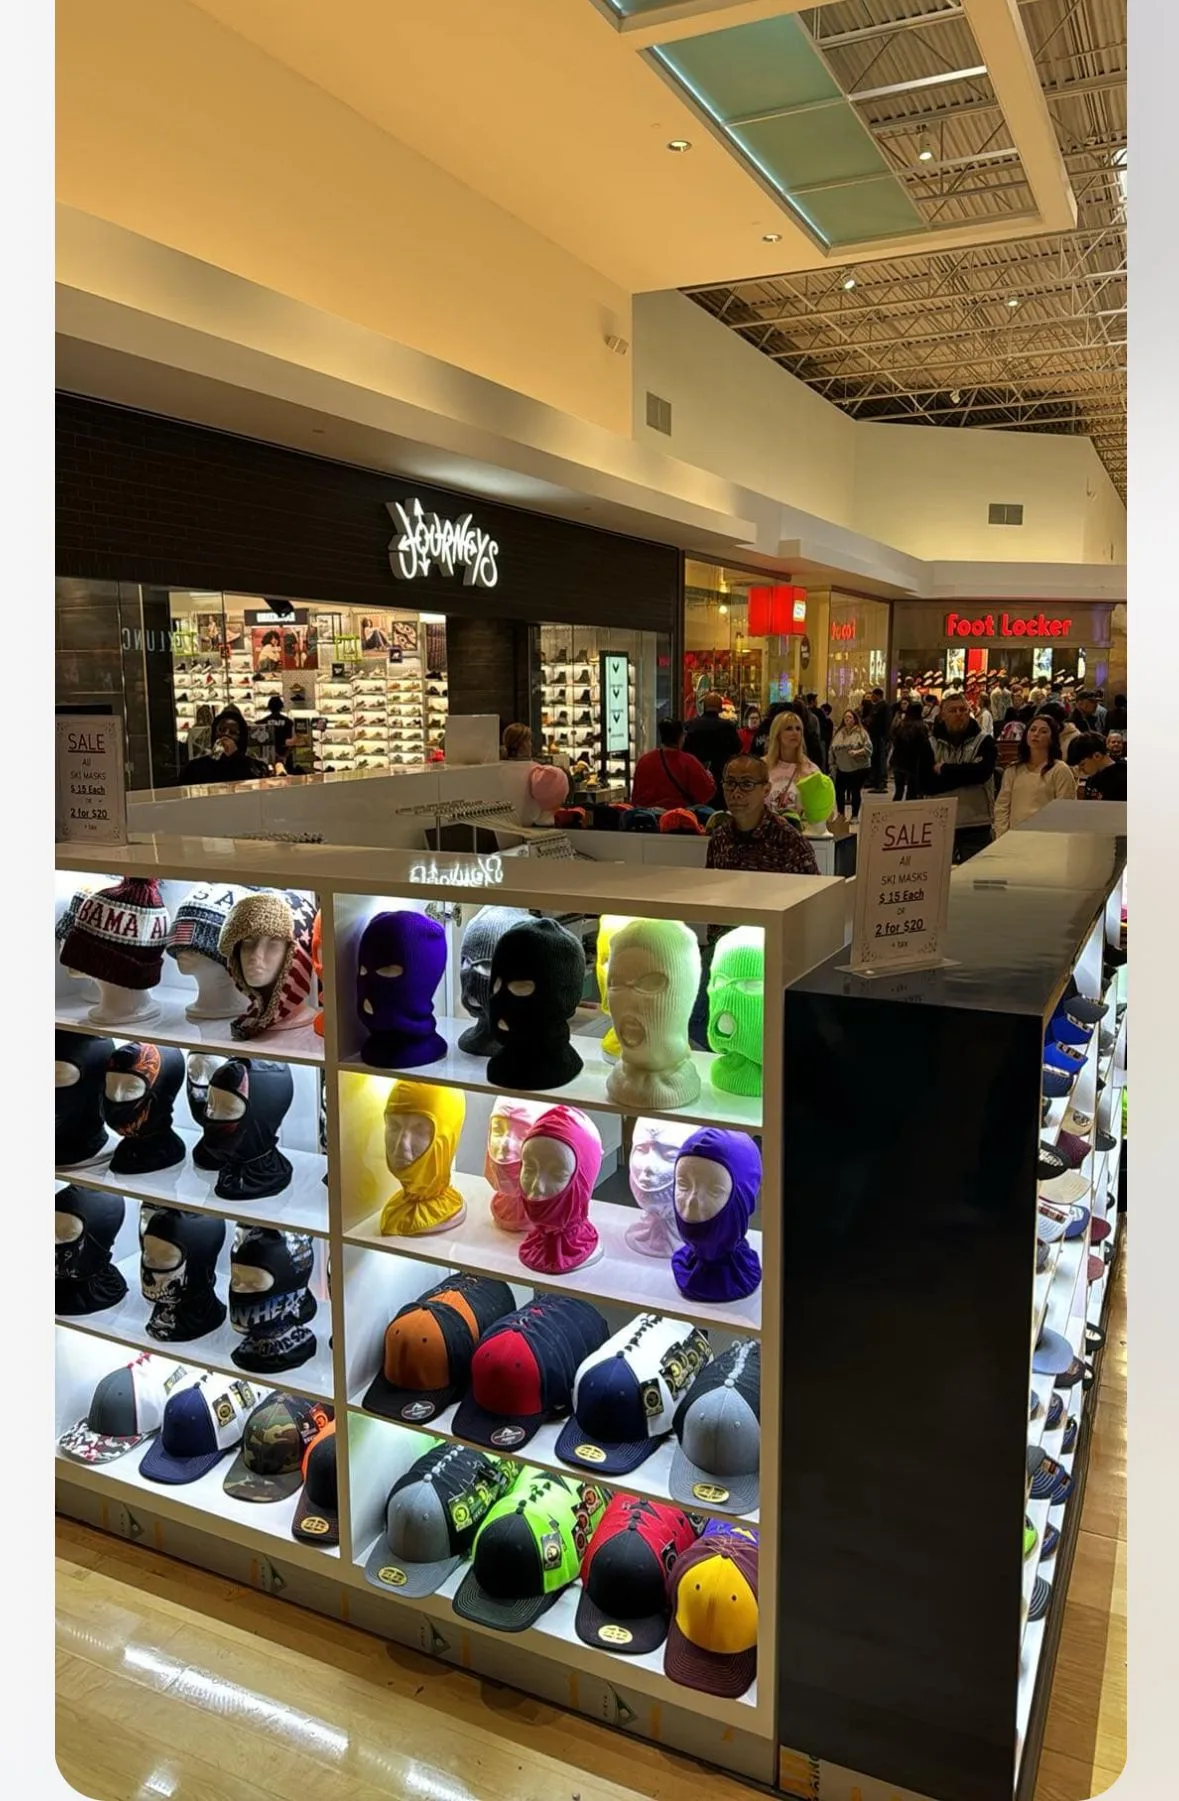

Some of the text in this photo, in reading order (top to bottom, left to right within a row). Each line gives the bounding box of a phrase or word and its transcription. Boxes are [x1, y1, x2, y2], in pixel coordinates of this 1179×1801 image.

[946, 611, 1073, 637] Foot Locker
[67, 733, 105, 751] SALE
[88, 785, 106, 794] Each
[70, 808, 108, 819] 2 for $20
[883, 822, 933, 847] SALE
[899, 855, 912, 867] All
[881, 871, 928, 886] SKI MASKS
[903, 887, 925, 901] Each
[875, 918, 924, 936] 2 for $20
